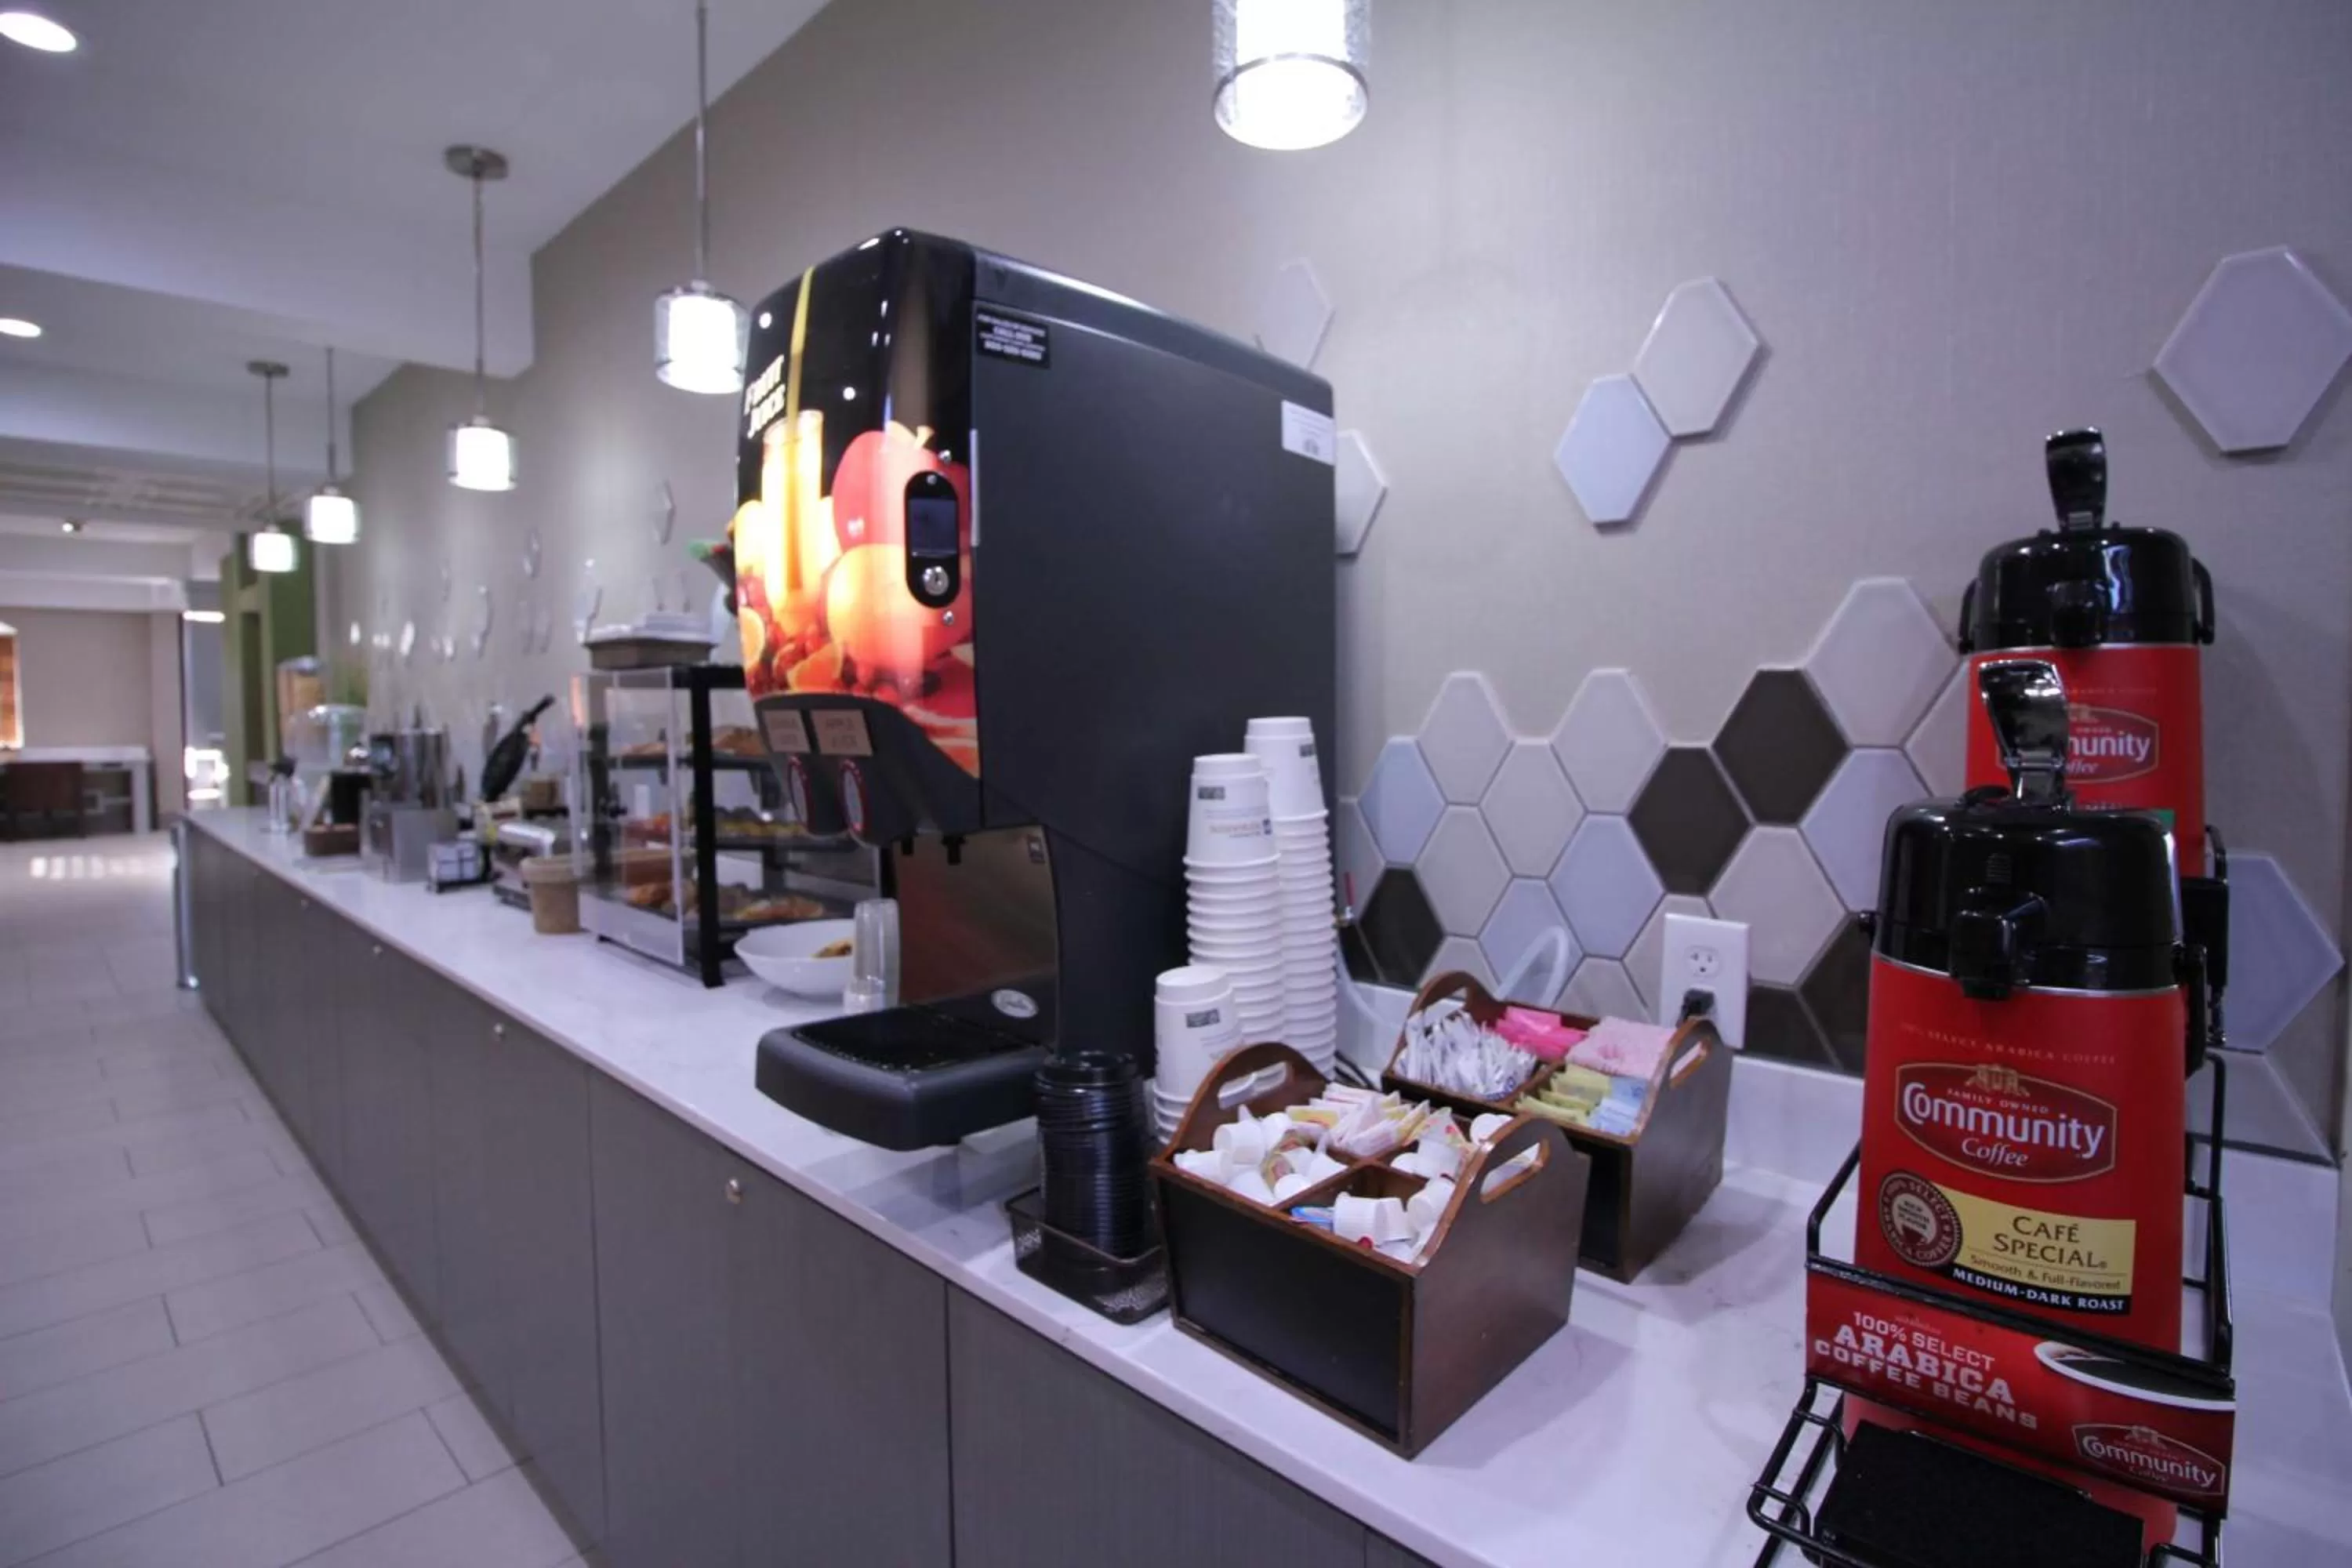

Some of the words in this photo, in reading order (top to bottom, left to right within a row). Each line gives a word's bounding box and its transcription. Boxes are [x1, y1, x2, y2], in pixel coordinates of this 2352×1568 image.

[1903, 1081, 2105, 1160] Community
[1947, 1087, 1992, 1105] FAMILY
[1999, 1099, 2049, 1114] OWNED
[1961, 1137, 2029, 1167] Coffee
[2012, 1215, 2082, 1243] CAFÉ
[1952, 1267, 2072, 1307] MEDIUM-DARK
[2077, 1297, 2125, 1312] ROAST
[1970, 1254, 2022, 1276] Smooth
[2027, 1269, 2038, 1280] &
[2042, 1272, 2122, 1290] Full-Flavored
[1833, 1324, 2016, 1406] ARABICA
[1853, 1311, 1907, 1343] 100%
[1911, 1331, 1996, 1371] SELECT
[1813, 1338, 1921, 1389] COFFEE
[1933, 1380, 2038, 1431] BEANS
[2082, 1435, 2218, 1488] Community
